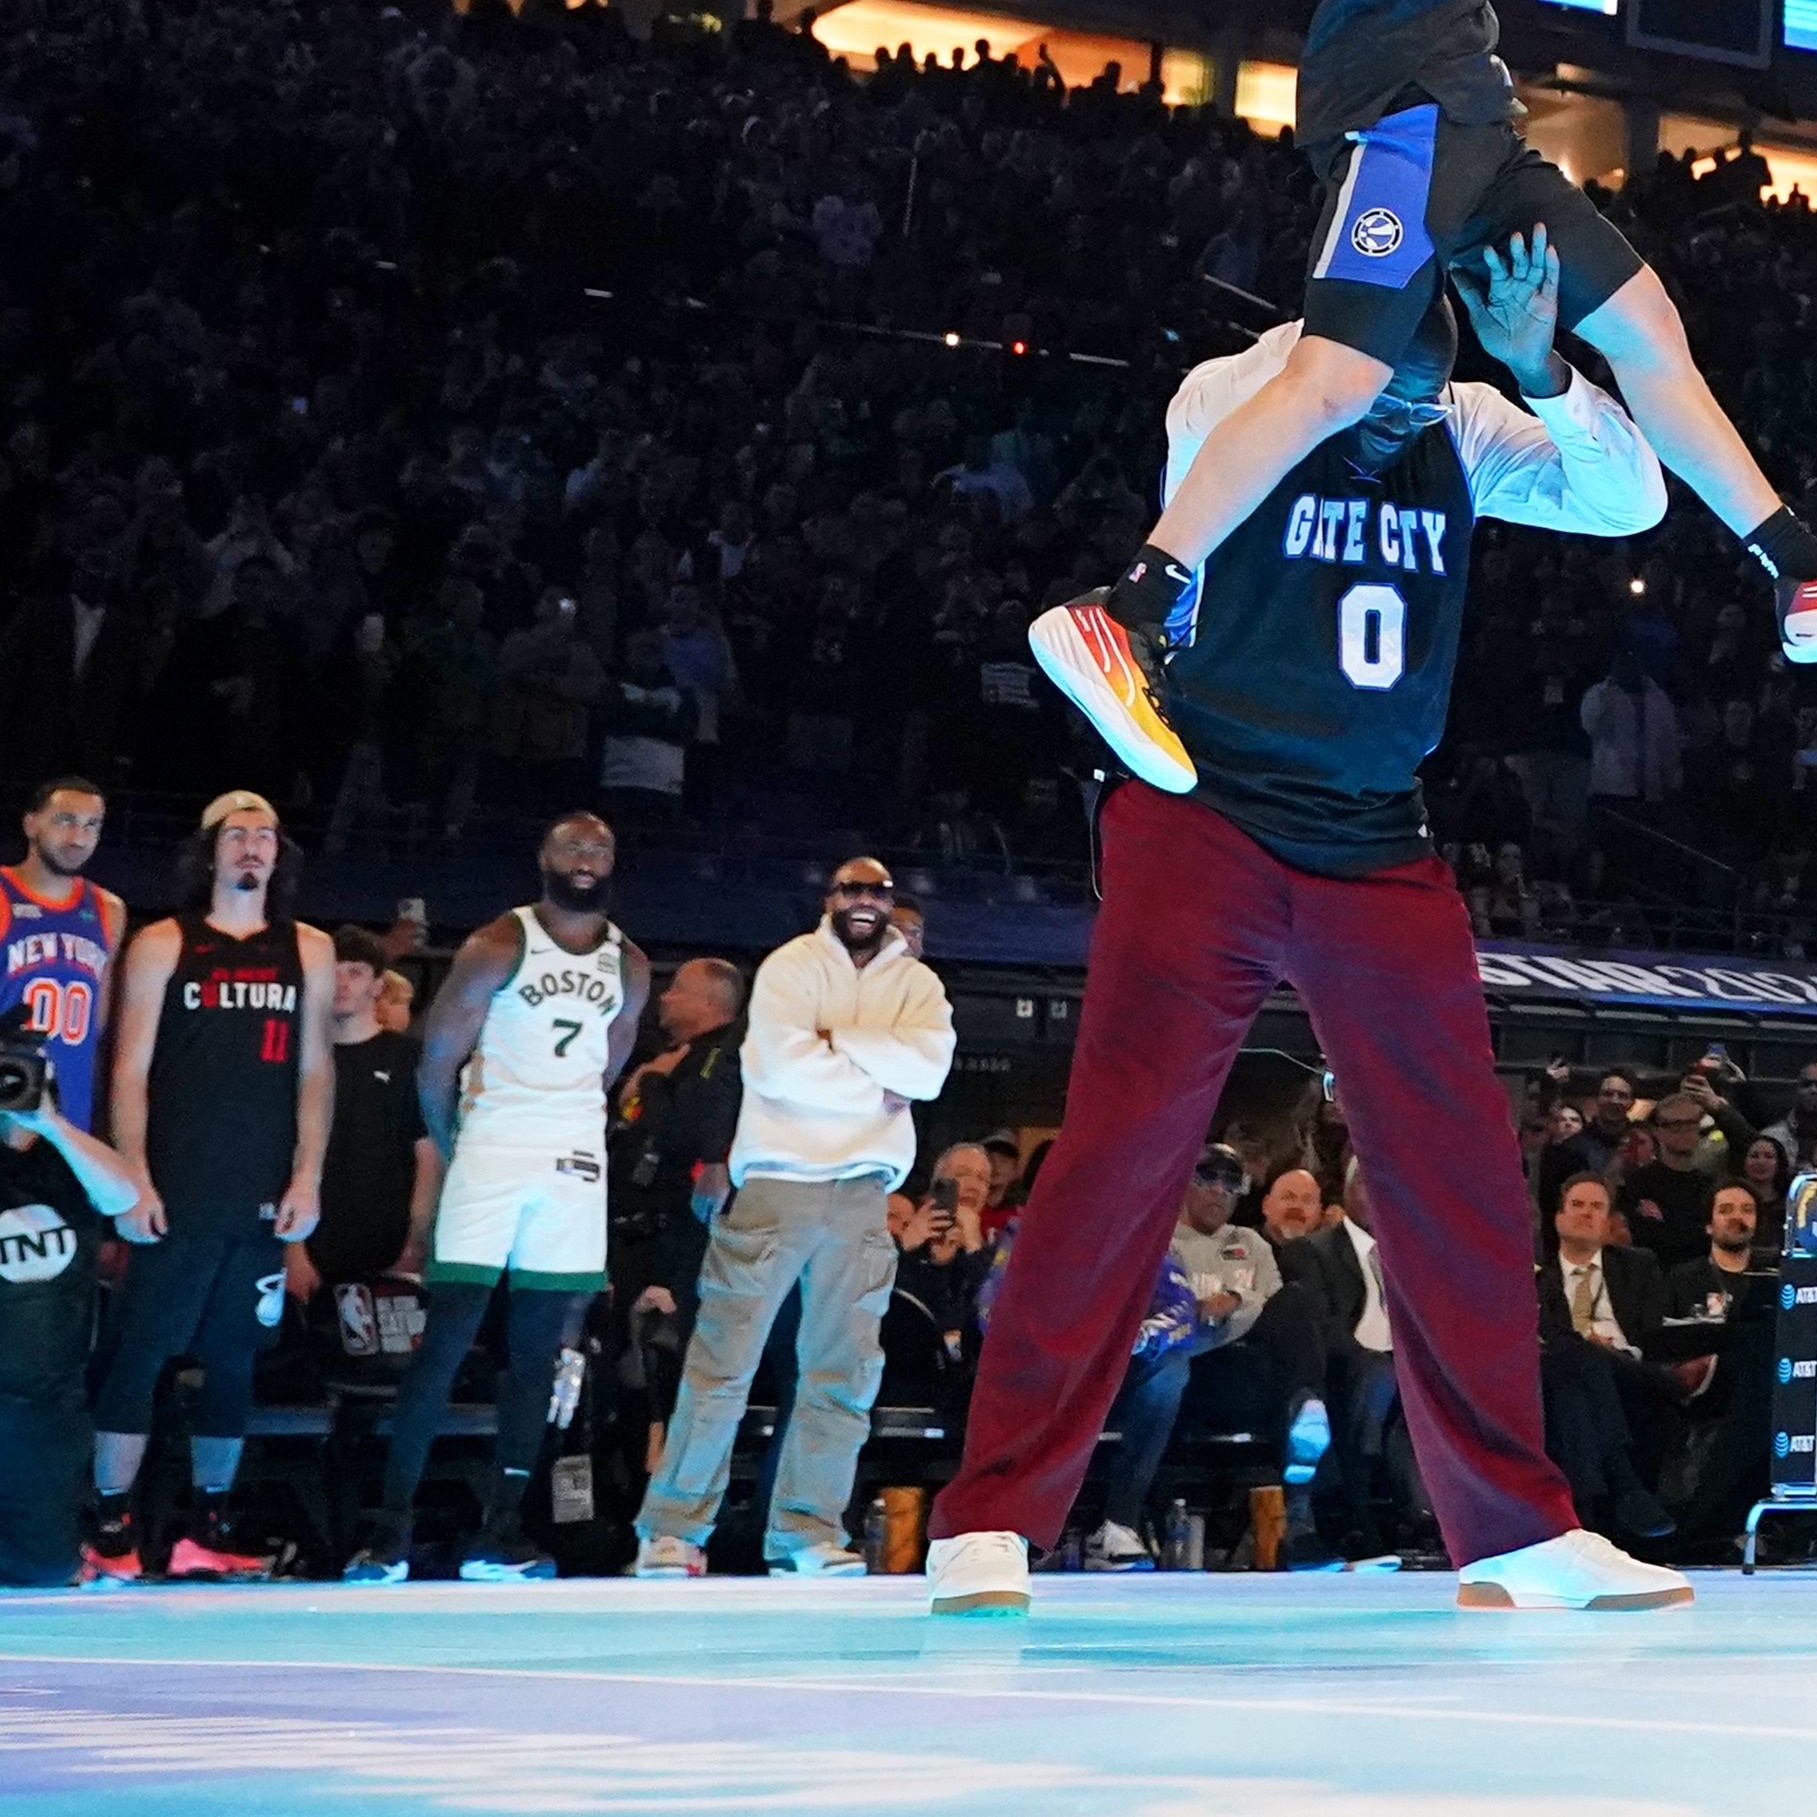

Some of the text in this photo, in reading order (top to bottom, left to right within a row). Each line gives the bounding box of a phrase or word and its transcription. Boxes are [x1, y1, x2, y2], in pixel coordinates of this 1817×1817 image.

[1377, 501, 1448, 577] CTY
[1336, 580, 1409, 693] 0
[6, 931, 58, 979] NEW
[183, 981, 297, 1014] CULTURA
[518, 969, 618, 1018] BOSTON
[260, 1018, 290, 1064] 11
[552, 1018, 584, 1058] 7
[1792, 1360, 1817, 1378] AT&T
[1789, 1435, 1815, 1453] AT&T
